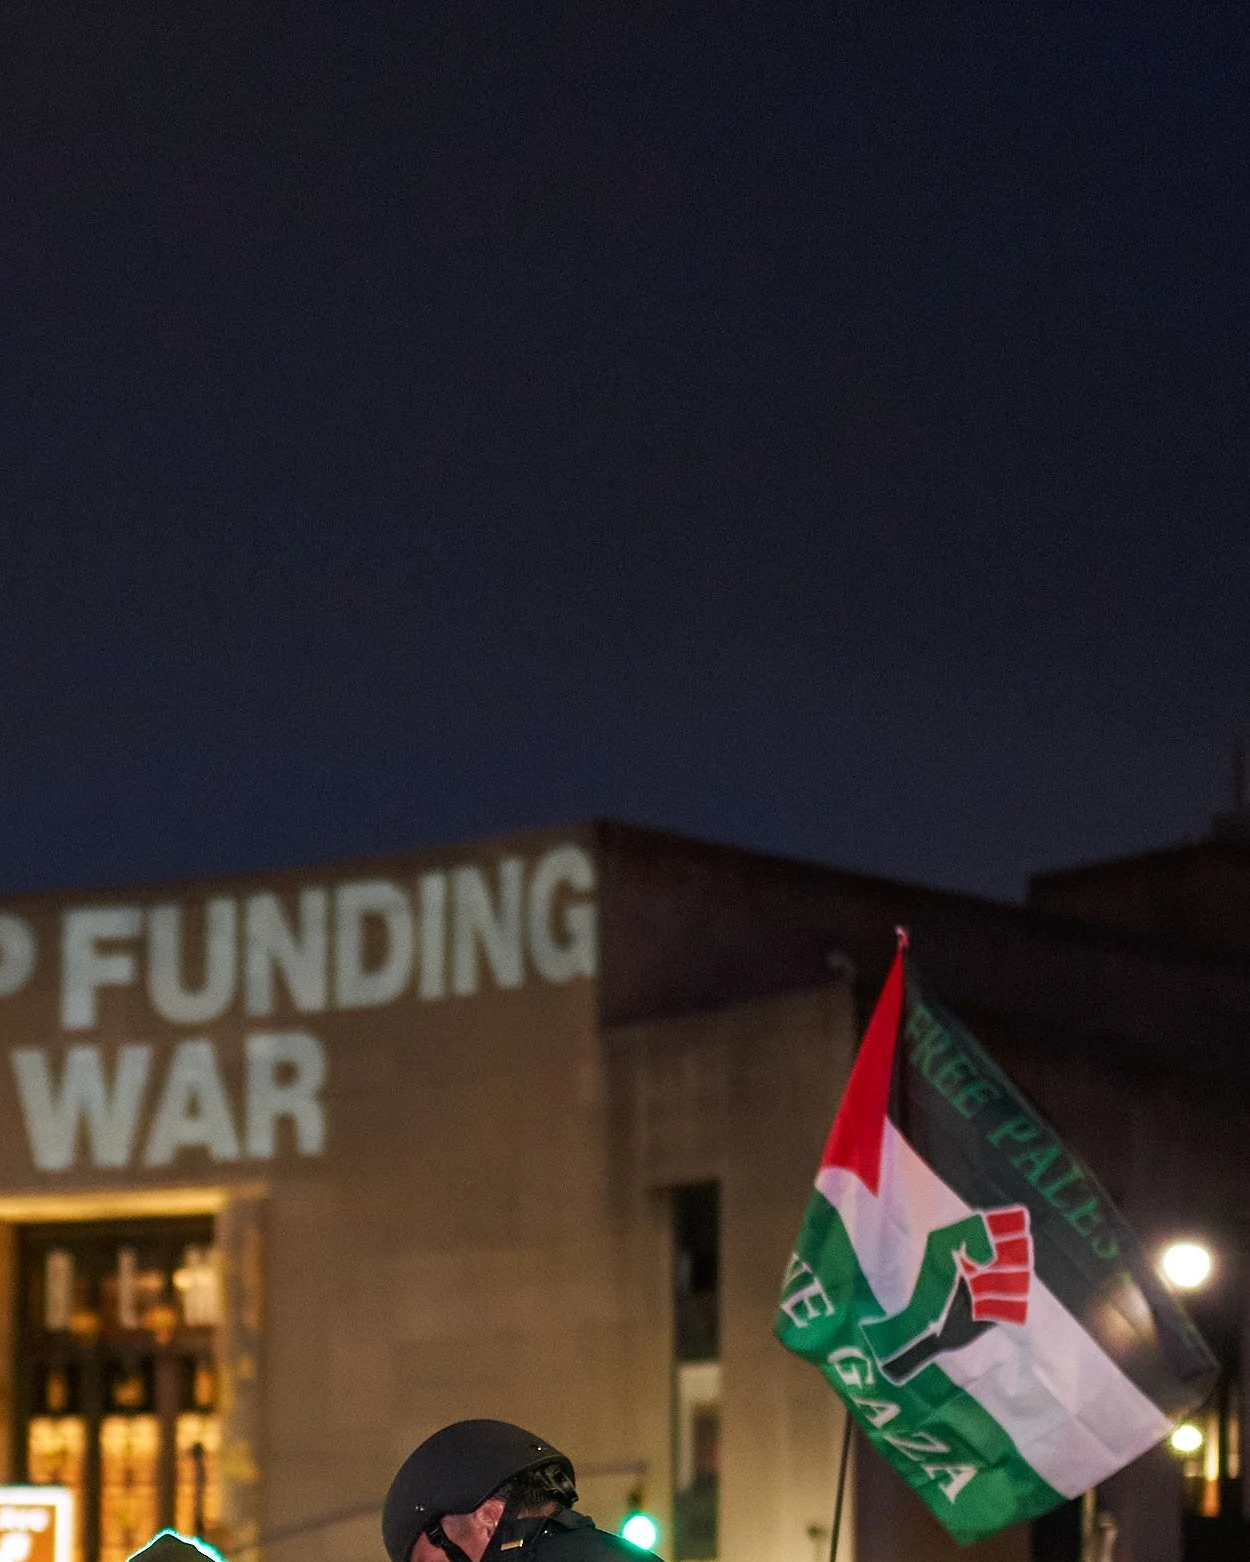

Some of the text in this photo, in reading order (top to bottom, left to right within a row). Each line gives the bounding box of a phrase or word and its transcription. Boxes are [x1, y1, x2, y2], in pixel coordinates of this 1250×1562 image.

[61, 846, 599, 1031] FUNDING
[12, 1031, 327, 1171] WAR
[986, 1113, 1120, 1260] PALES
[827, 1345, 979, 1505] GAZA
